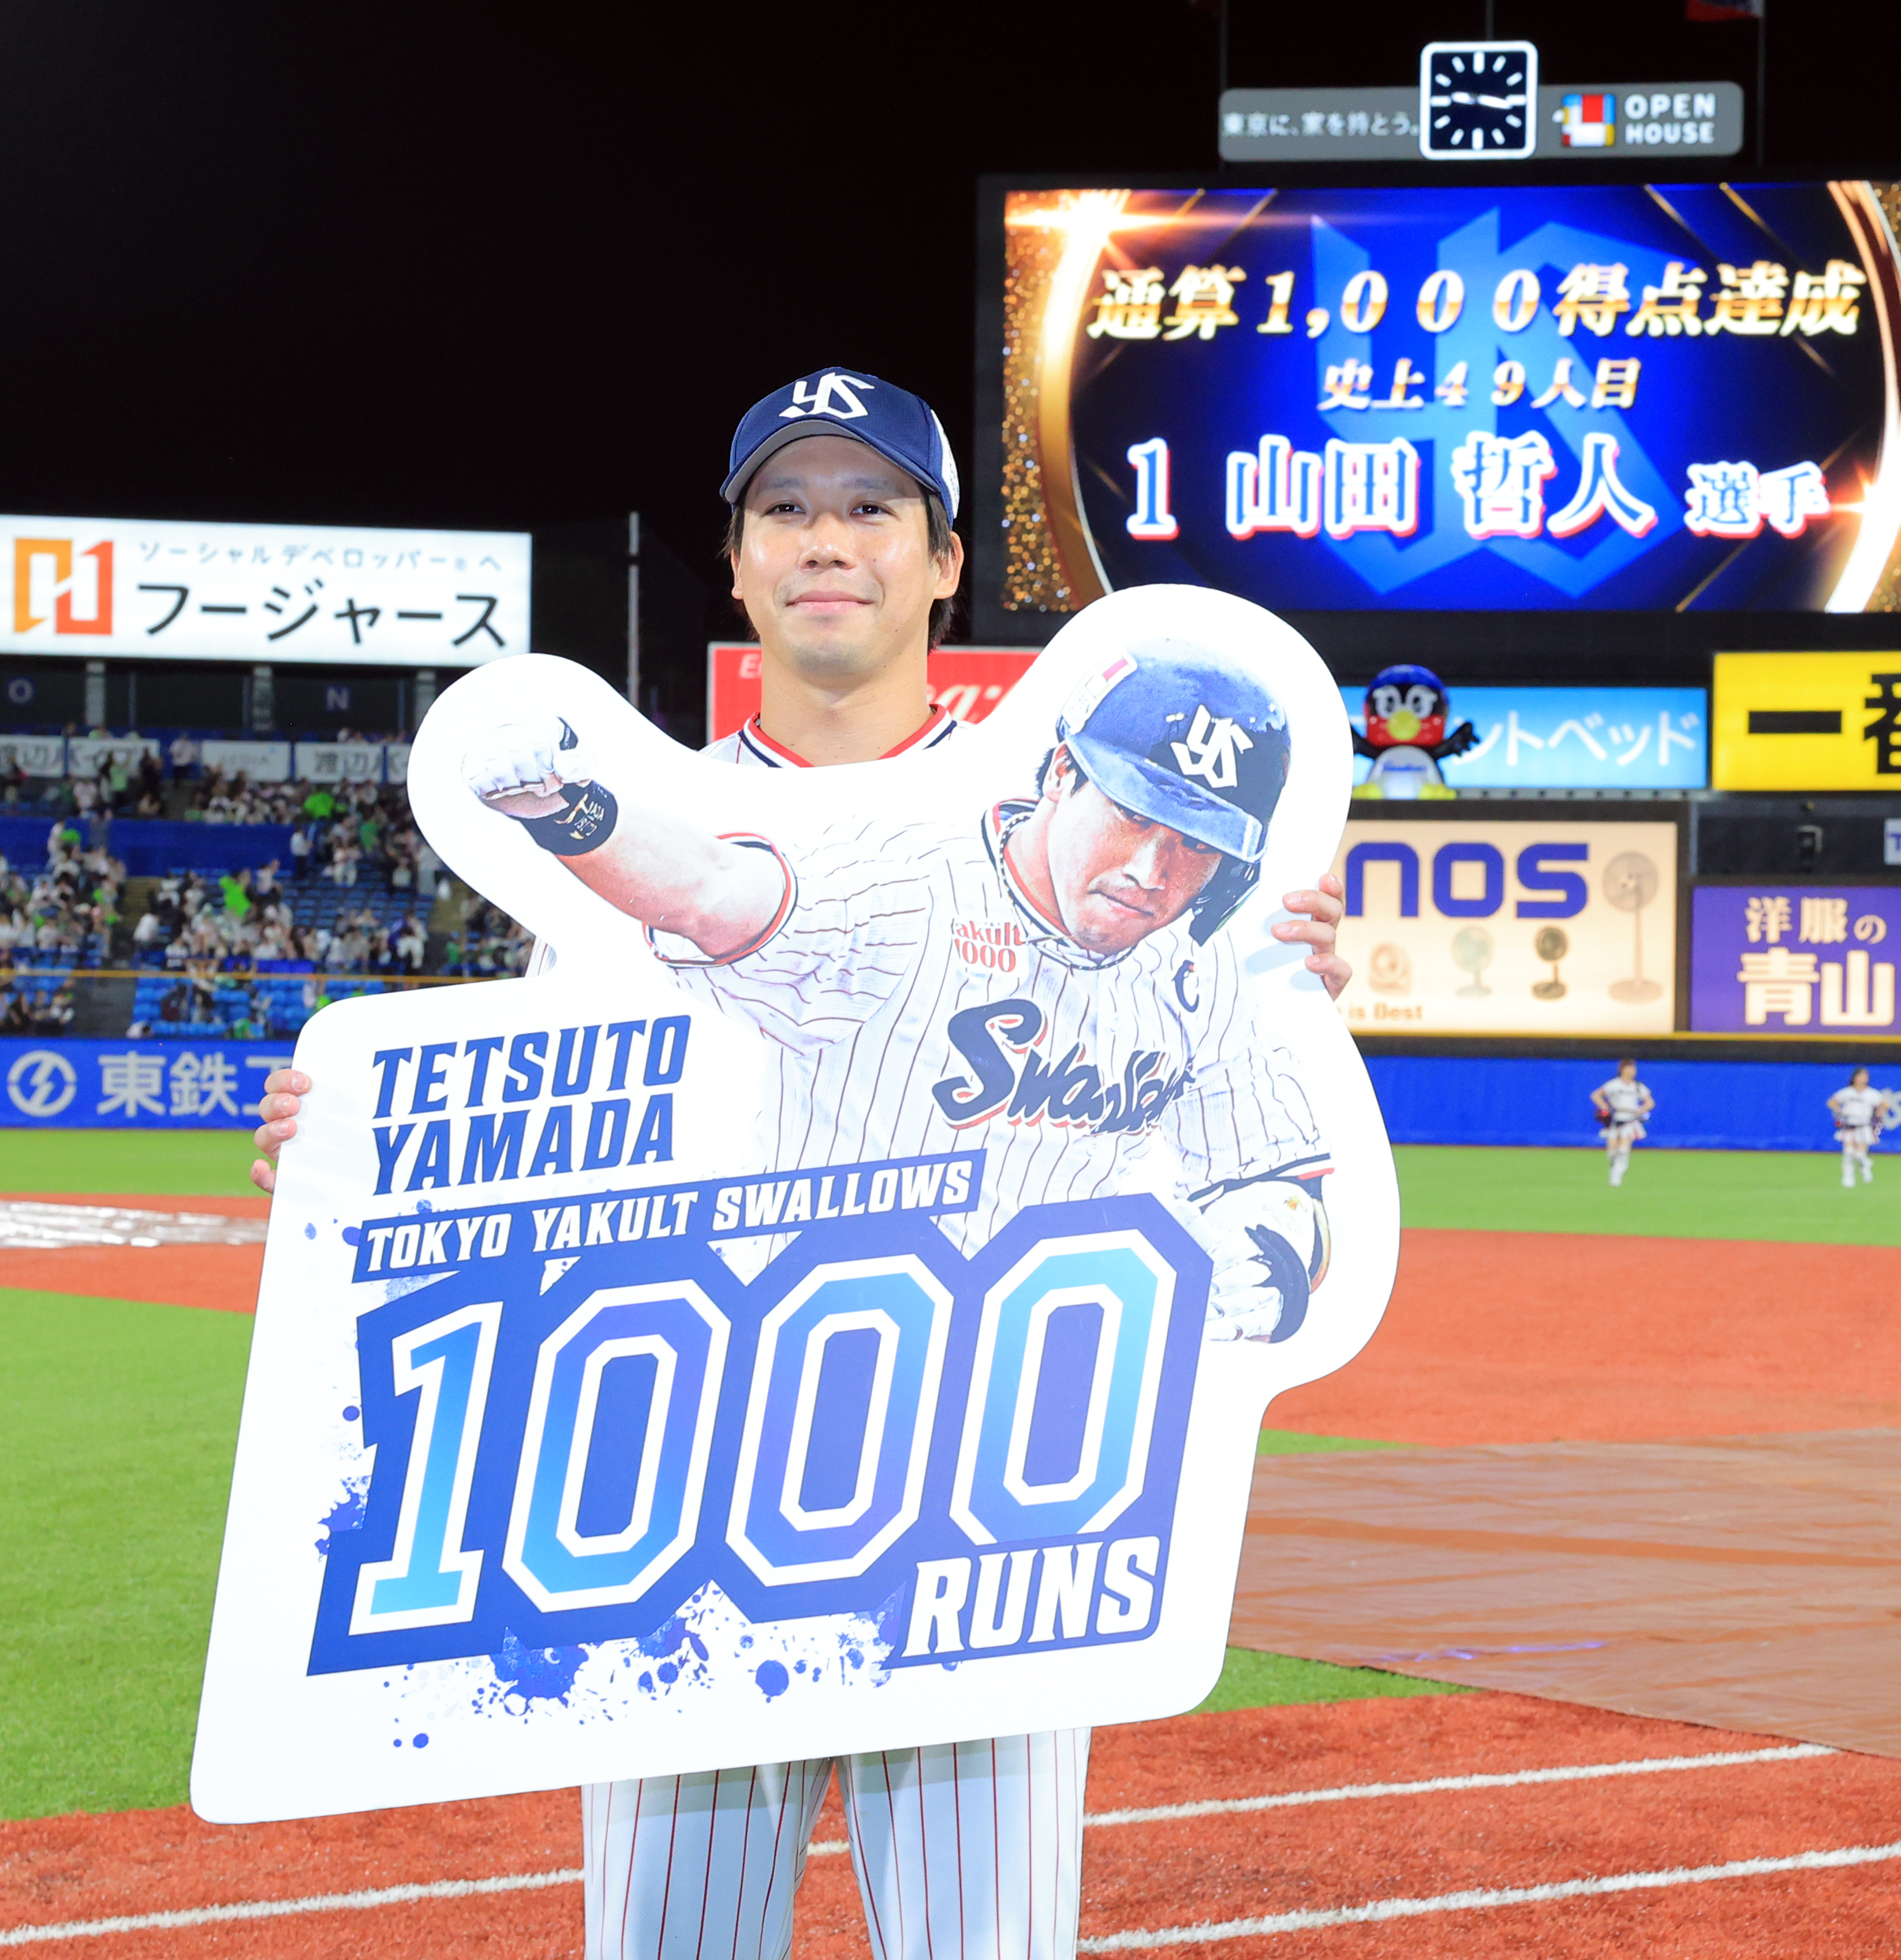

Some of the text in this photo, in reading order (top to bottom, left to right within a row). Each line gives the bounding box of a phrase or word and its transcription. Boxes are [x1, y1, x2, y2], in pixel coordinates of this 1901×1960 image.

[1624, 93, 1716, 119] OPEN
[1625, 122, 1715, 144] HOUSE
[1126, 429, 1831, 537] 1 山田 哲人 選手
[137, 579, 507, 647] フージャース
[1744, 896, 1888, 945] 洋服の
[1736, 947, 1896, 1026] 青山
[372, 1015, 692, 1120] TETSUTO
[373, 1093, 674, 1196] YAMADA
[367, 1160, 975, 1272] TOKYO YAKULT SWALLOWS
[348, 1228, 1178, 1636] 1000
[901, 1536, 1161, 1658] RUNS
